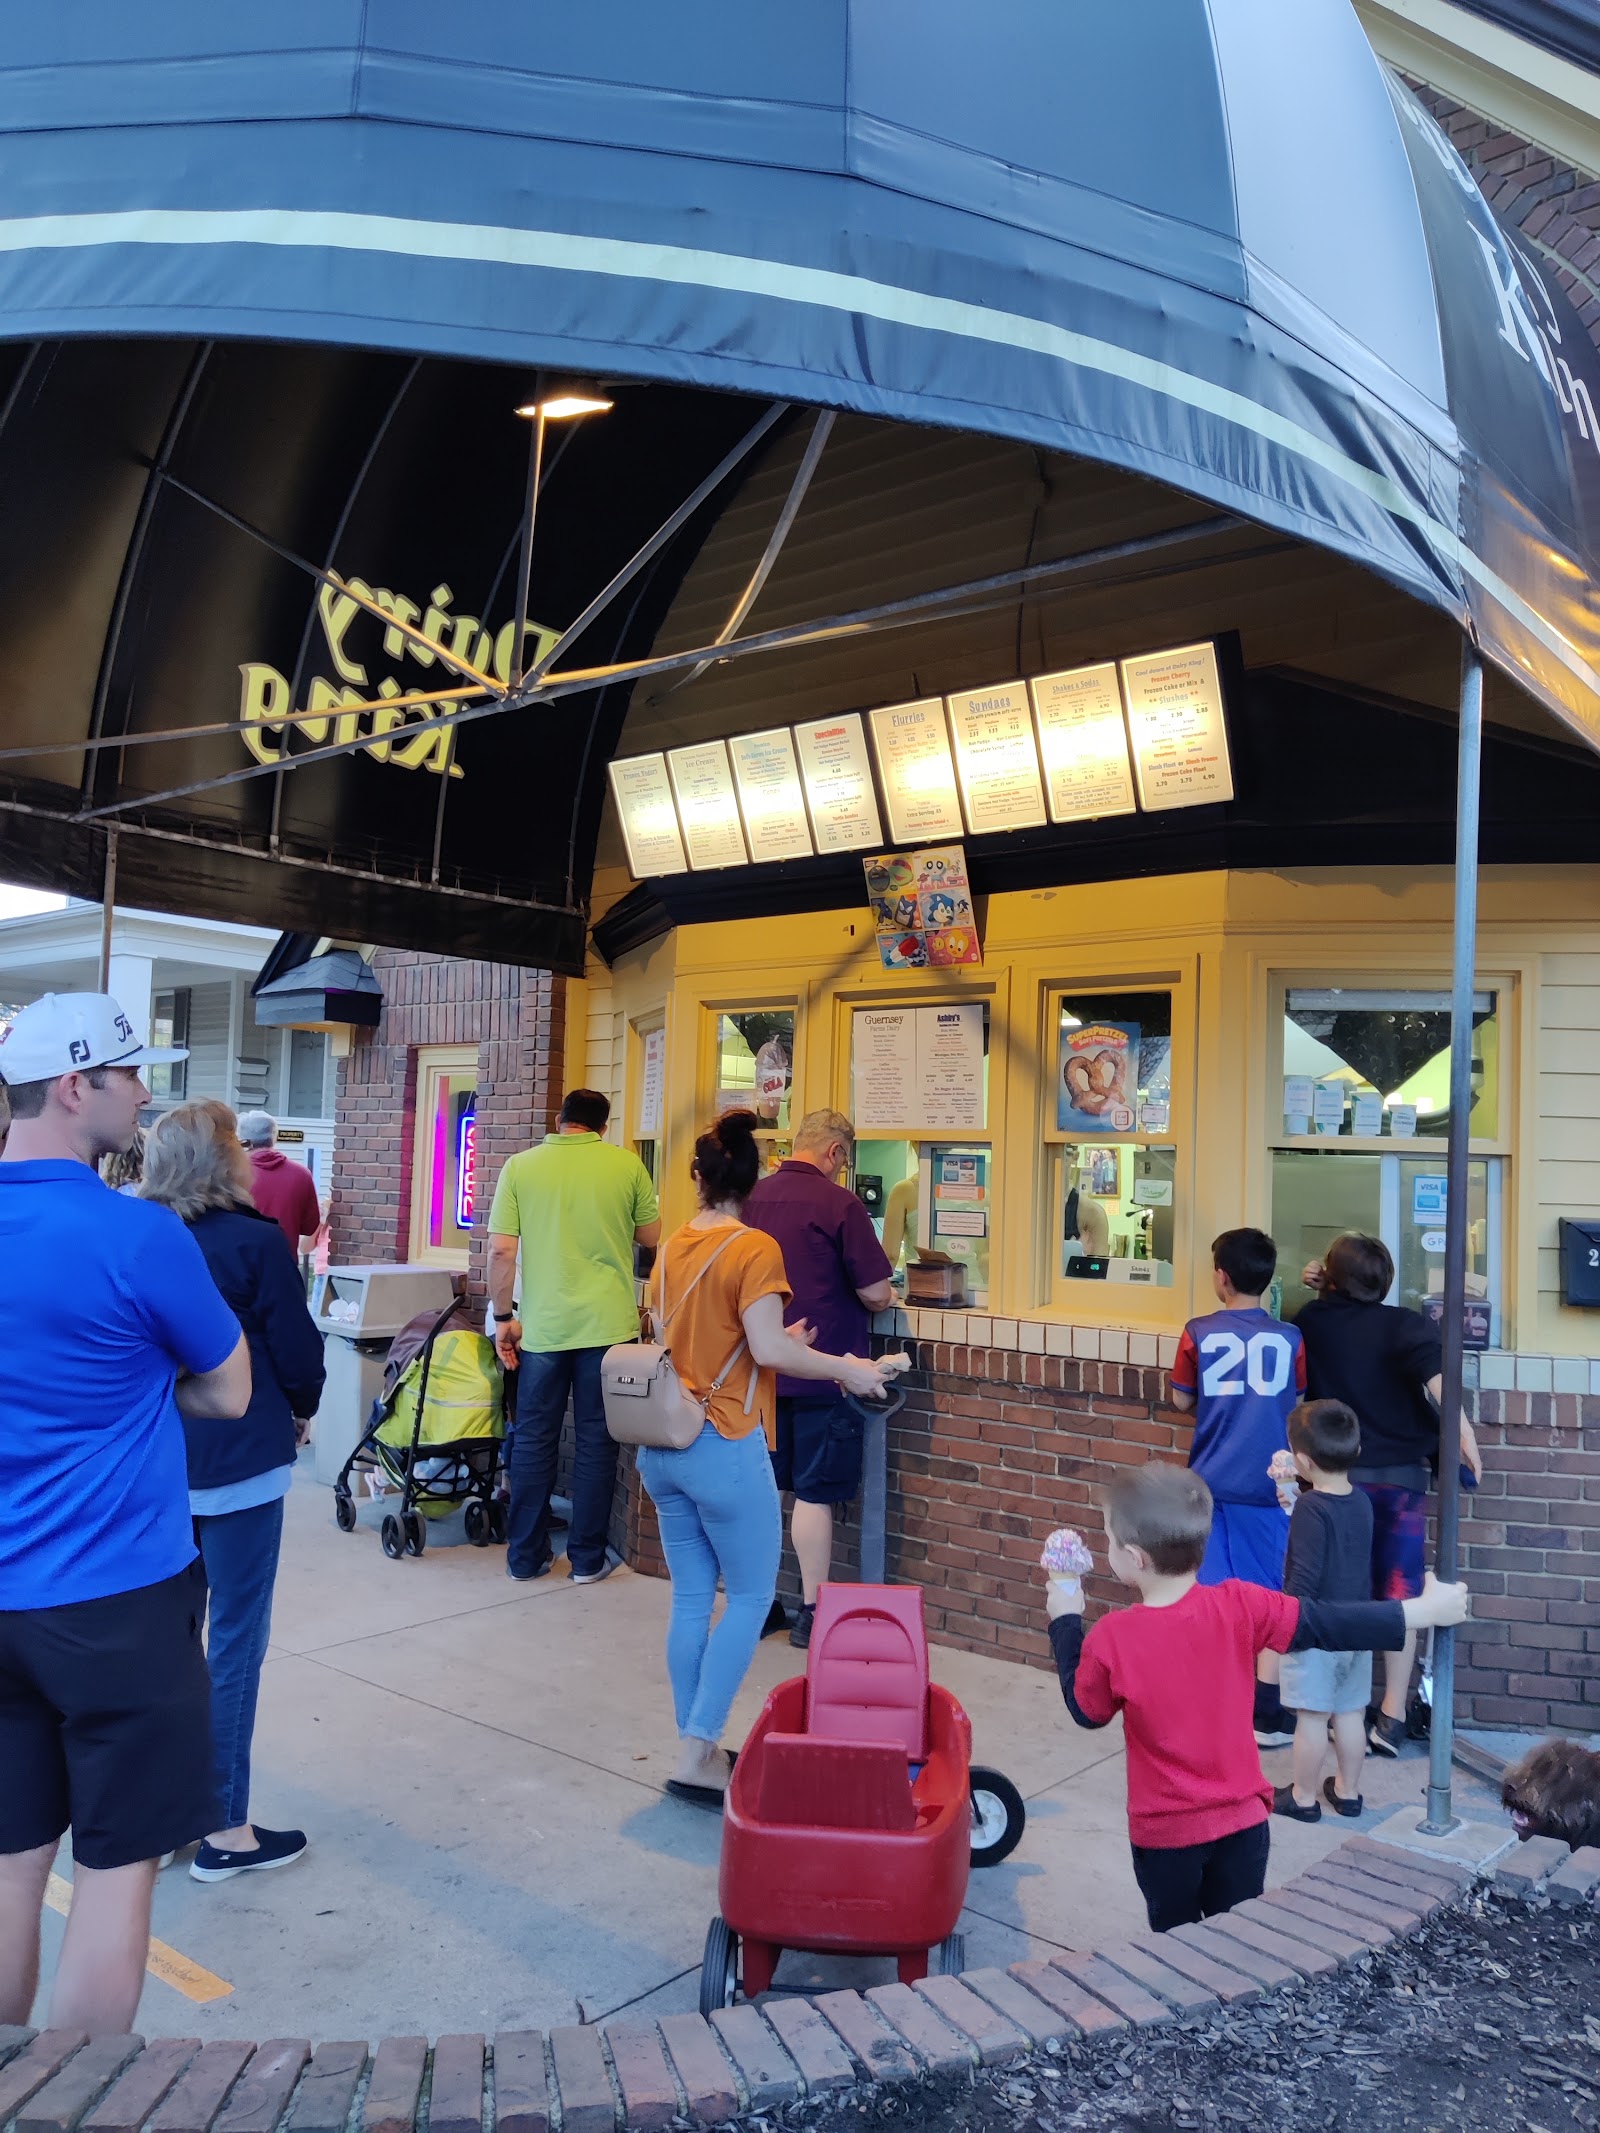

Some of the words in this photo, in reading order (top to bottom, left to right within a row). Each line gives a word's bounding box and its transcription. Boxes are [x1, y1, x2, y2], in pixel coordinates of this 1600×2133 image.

[1171, 660, 1187, 670] Dairy
[1150, 674, 1170, 683] Frozen
[1170, 669, 1191, 680] Cherry
[1051, 681, 1074, 693] Shakes
[1079, 677, 1099, 688] Sodas
[1143, 685, 1163, 695] Frozen
[1186, 678, 1198, 687] Mix
[967, 693, 1011, 714] Sundaes
[1158, 691, 1189, 705] Slushes
[891, 710, 926, 727] Flurries
[983, 710, 1001, 718] premium
[771, 746, 788, 754] Cream
[969, 746, 991, 755] Chocolate
[684, 760, 695, 768] Ice
[694, 756, 715, 766] Cream
[622, 771, 640, 780] Frozen
[640, 767, 657, 777] Yogurt
[1161, 770, 1178, 778] Frozen
[1193, 765, 1207, 773] Float
[864, 1015, 904, 1025] Guernsey
[937, 1013, 960, 1022] Ashby's
[69, 1039, 91, 1065] FJ
[1420, 1183, 1439, 1191] VISA
[1200, 1331, 1292, 1397] 20
